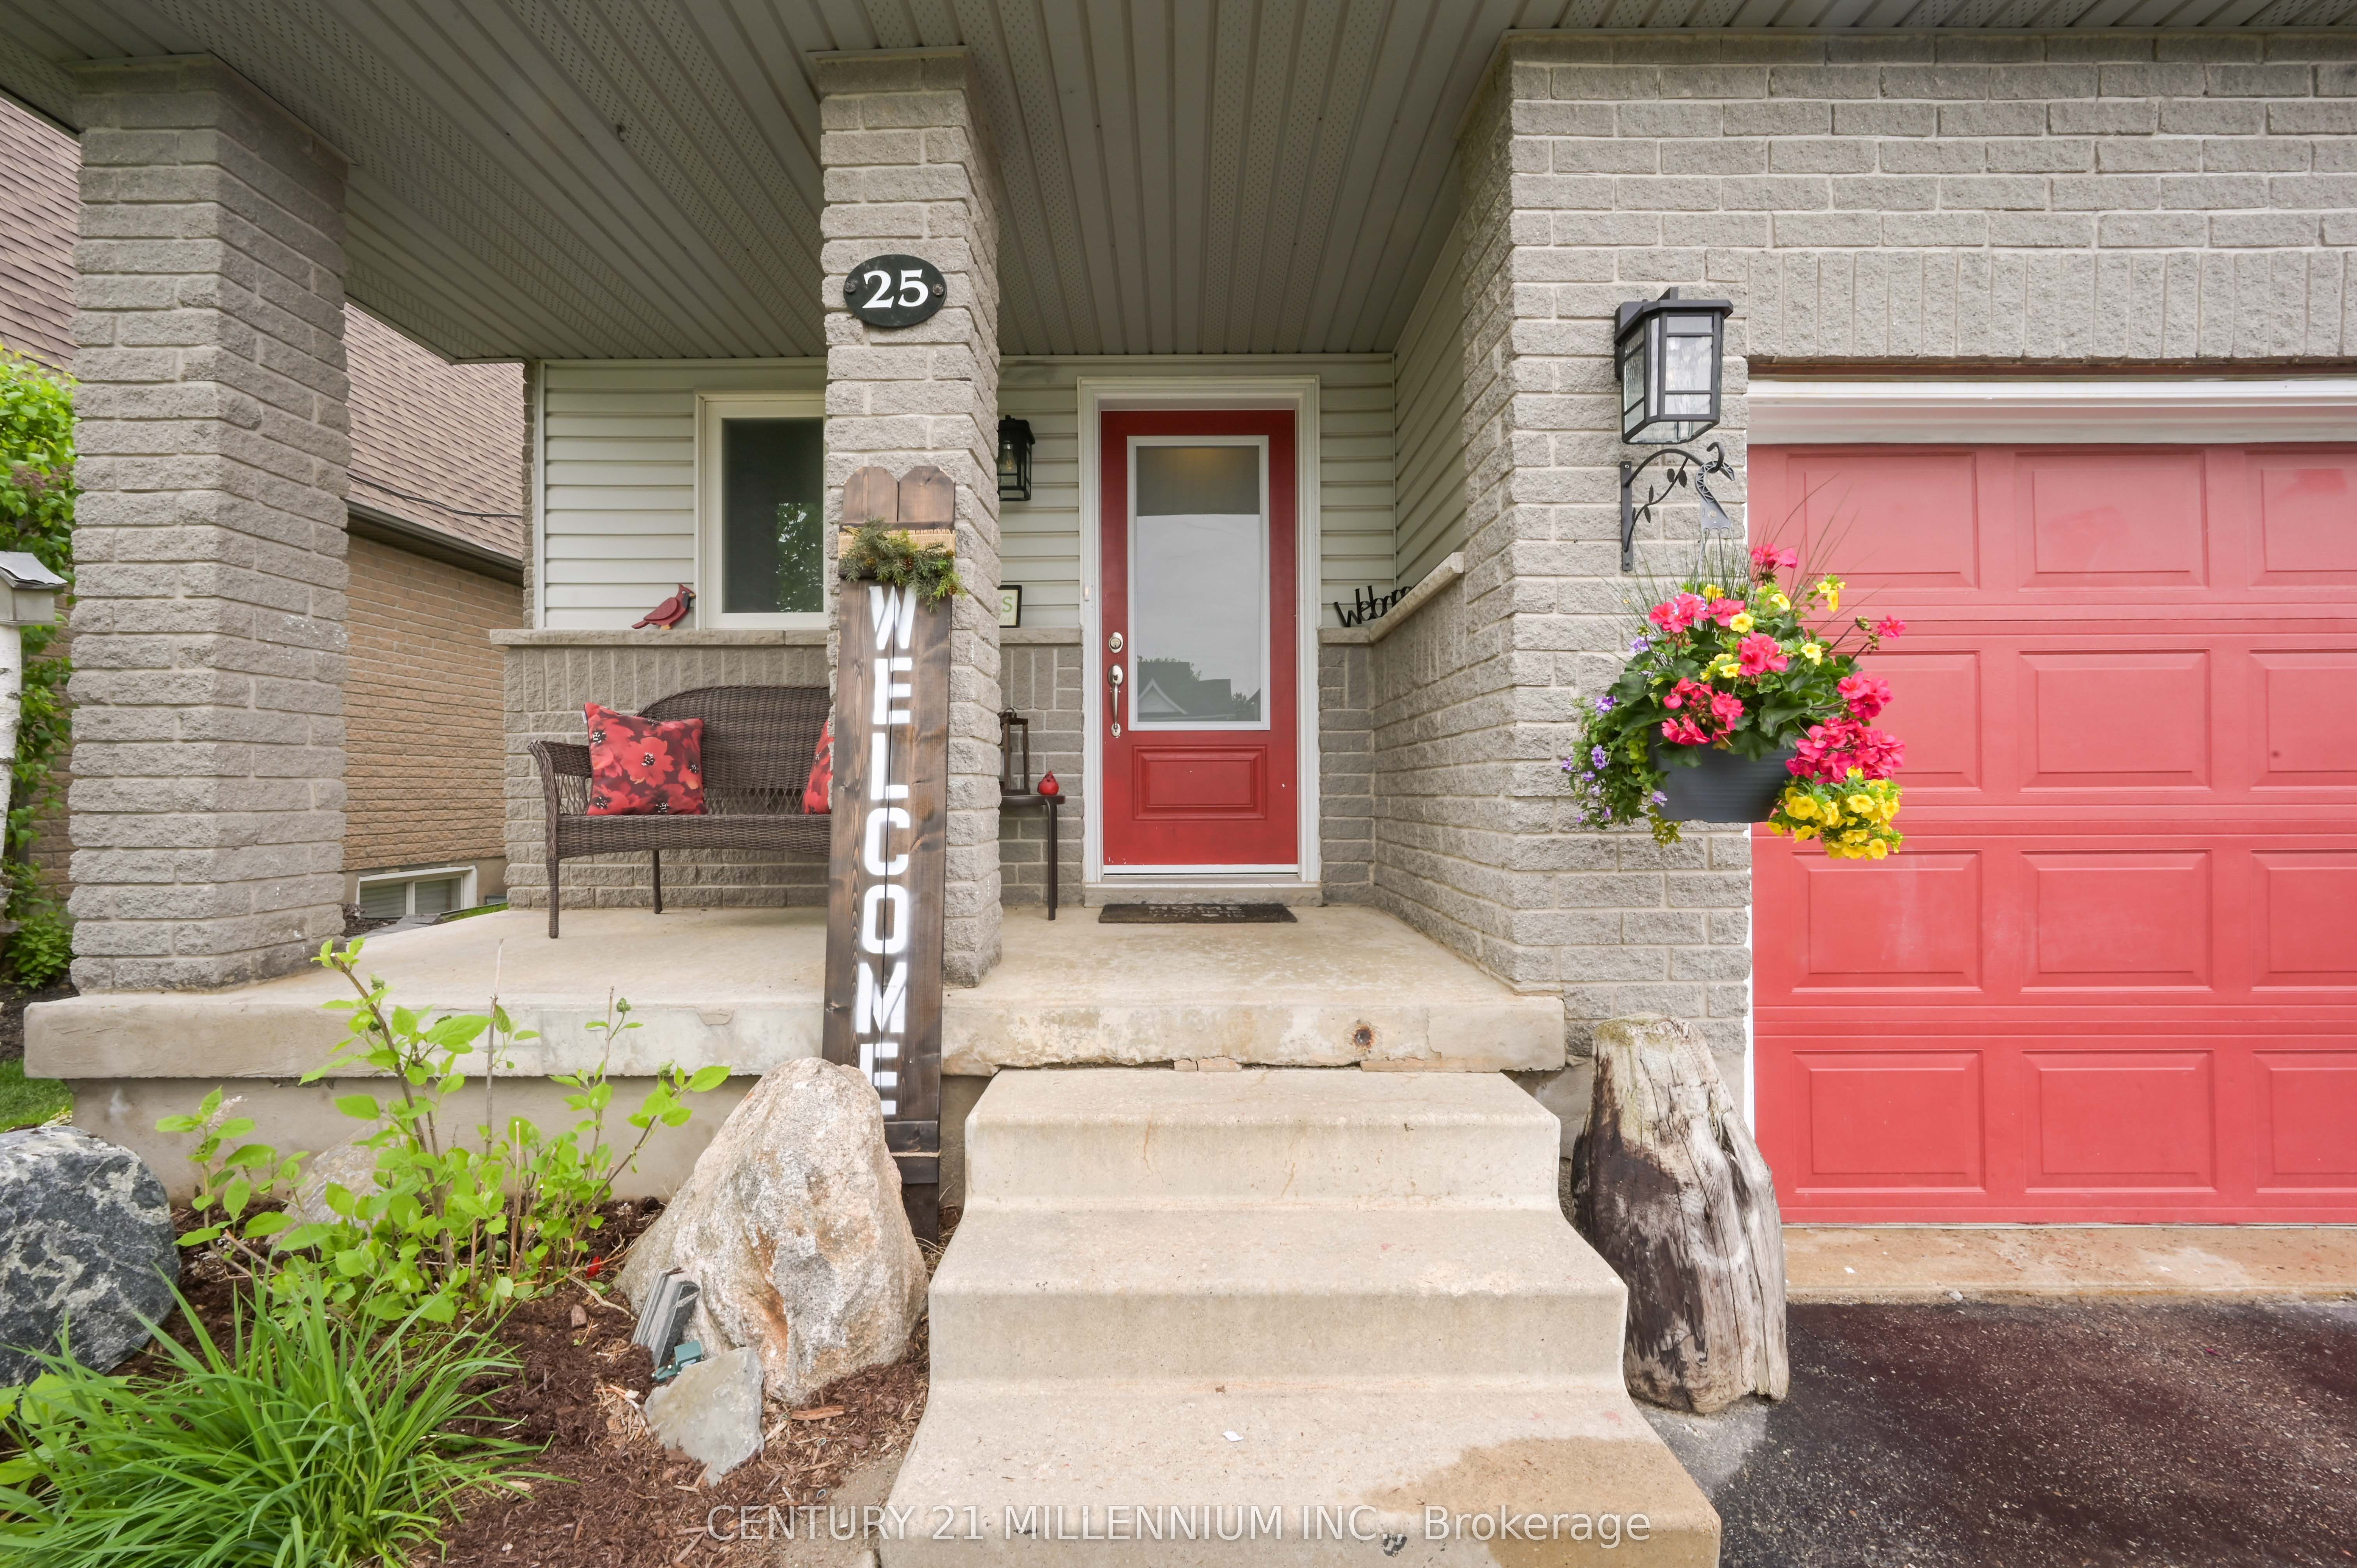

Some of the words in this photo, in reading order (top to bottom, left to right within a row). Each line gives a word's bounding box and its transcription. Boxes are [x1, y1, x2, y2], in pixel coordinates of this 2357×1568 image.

[862, 268, 929, 309] 25
[1333, 585, 1413, 628] Welcom
[856, 586, 918, 1115] WELCOME
